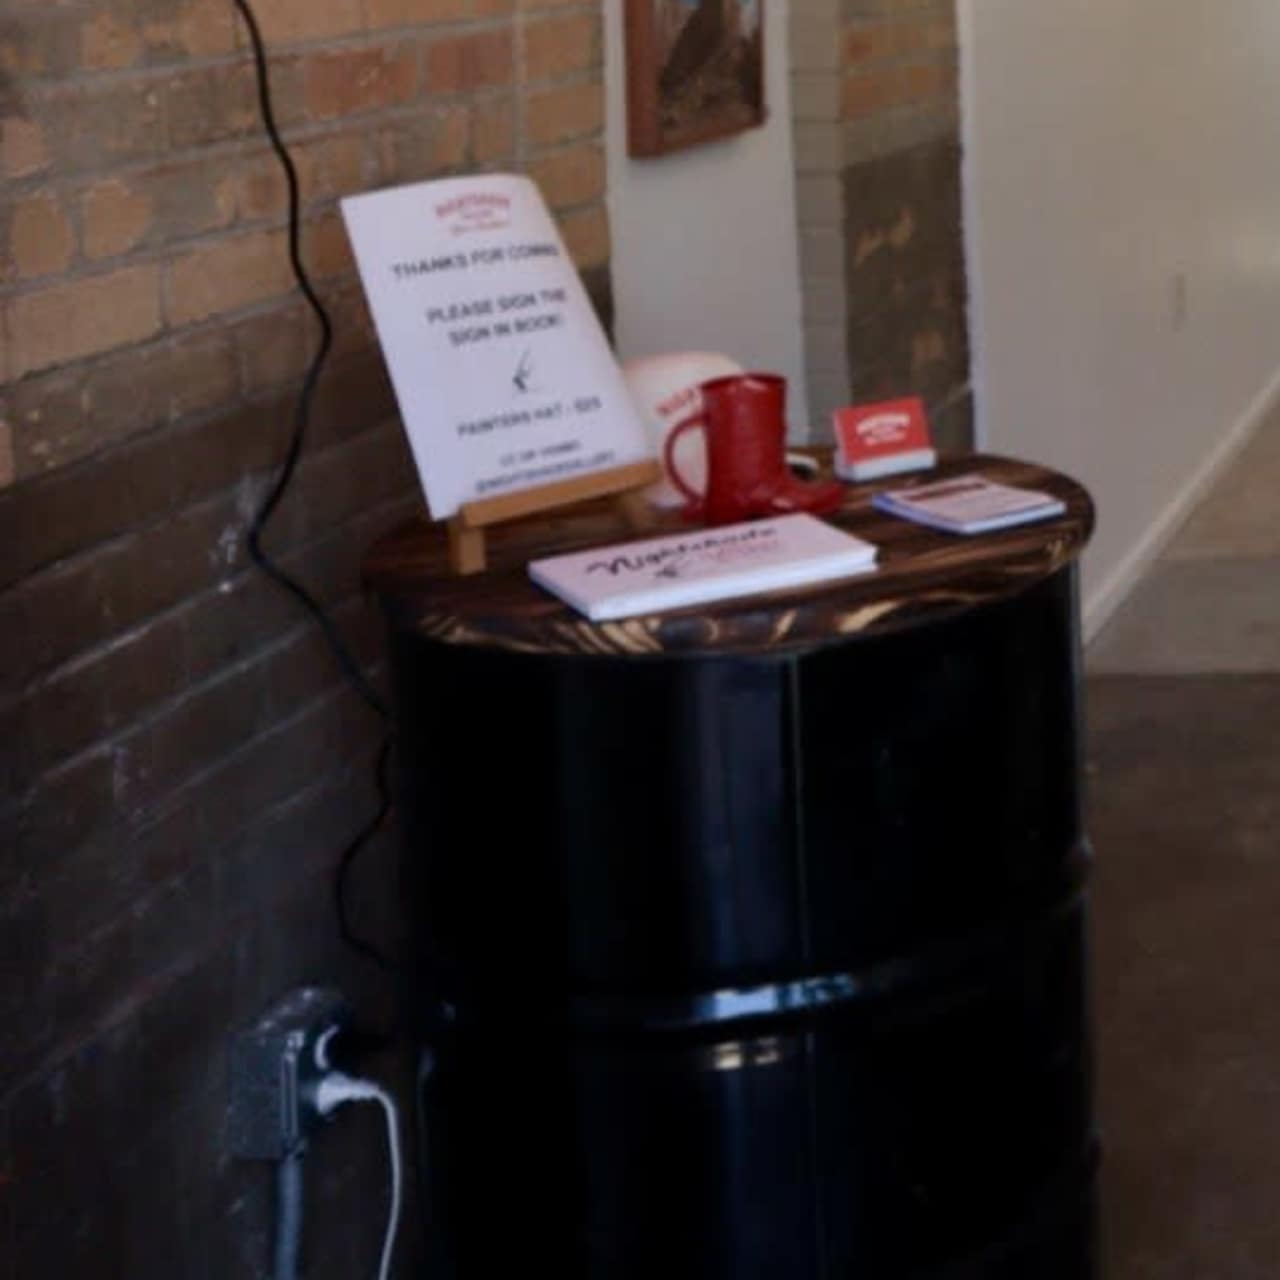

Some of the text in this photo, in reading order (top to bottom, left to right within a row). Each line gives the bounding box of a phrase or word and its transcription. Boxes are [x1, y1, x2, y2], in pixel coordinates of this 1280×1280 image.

[392, 253, 468, 278] THANKS
[470, 248, 504, 265] FOR
[426, 288, 567, 324] PLEASE SIGN THE
[448, 326, 491, 347] SIGN
[493, 322, 511, 336] IN
